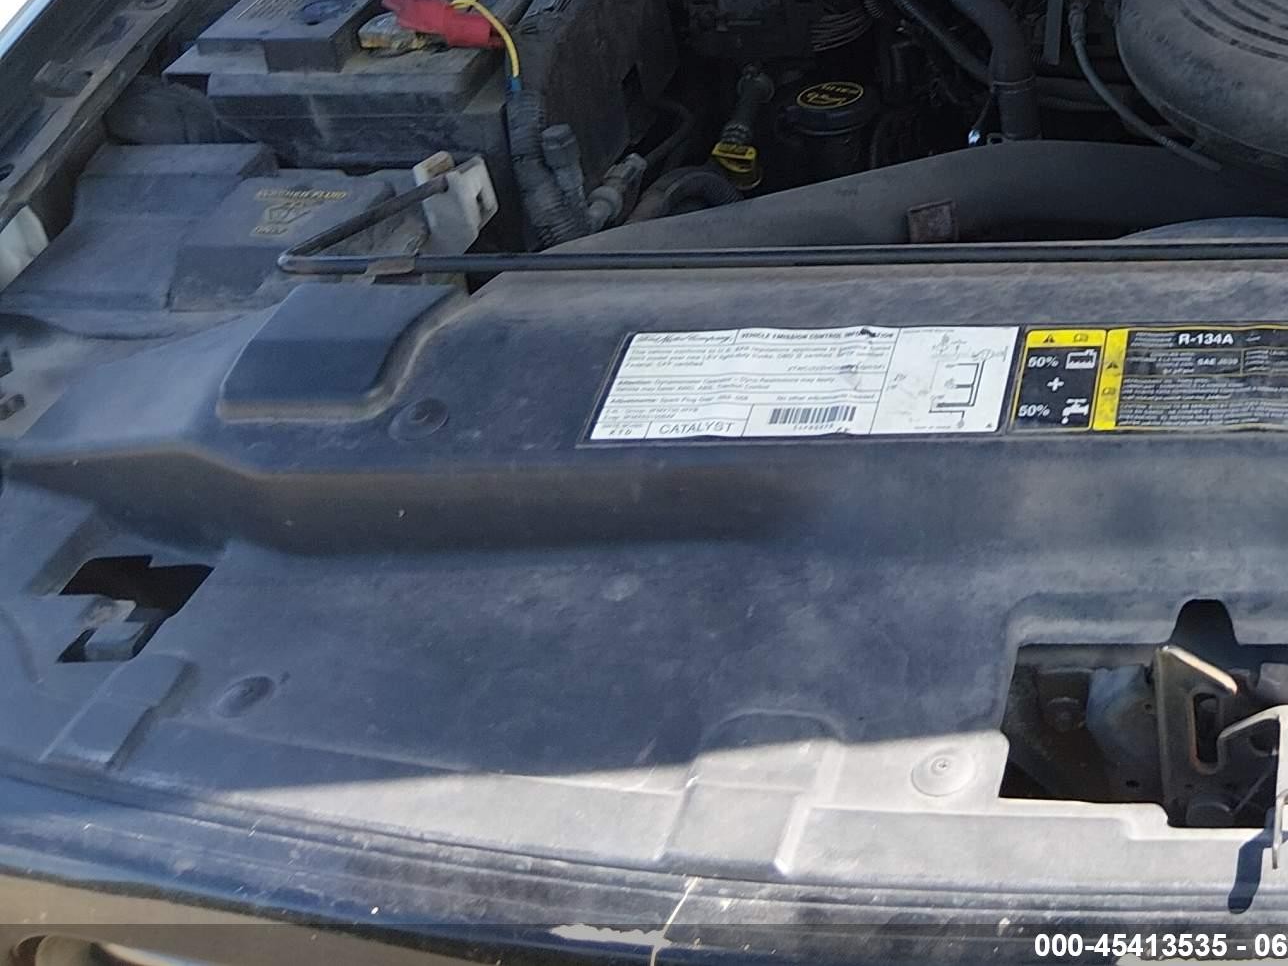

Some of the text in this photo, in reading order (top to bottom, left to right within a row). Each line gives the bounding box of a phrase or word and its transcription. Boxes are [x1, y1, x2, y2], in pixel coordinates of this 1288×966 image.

[1178, 333, 1234, 345] R-134A
[1028, 356, 1059, 368] 50%
[1018, 404, 1051, 417] 50%
[659, 421, 735, 435] CATALYST
